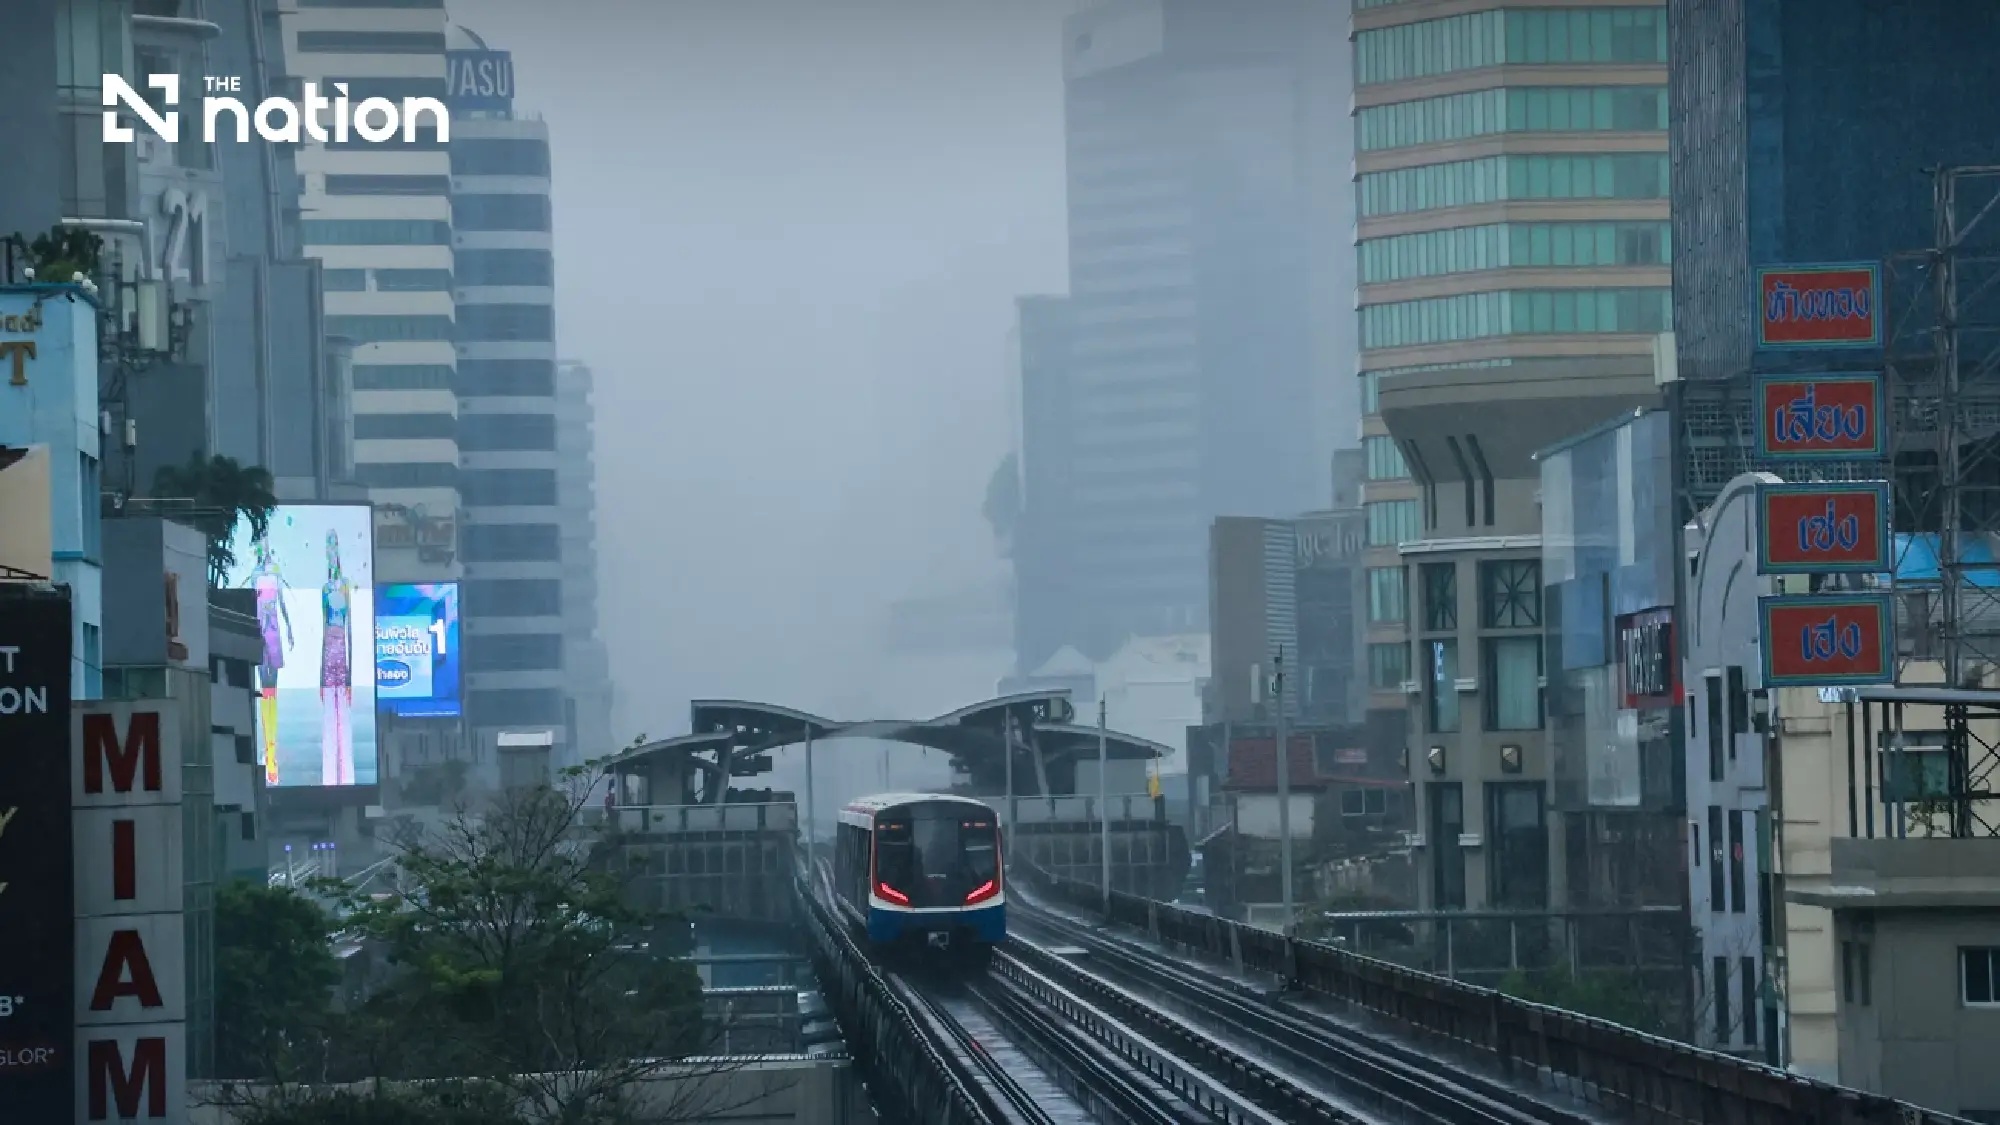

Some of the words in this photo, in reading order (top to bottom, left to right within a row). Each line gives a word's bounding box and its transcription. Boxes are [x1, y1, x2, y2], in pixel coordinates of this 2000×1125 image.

[1766, 280, 1870, 322] ห้างทอง
[428, 619, 446, 654] 1
[0, 686, 47, 714] ON
